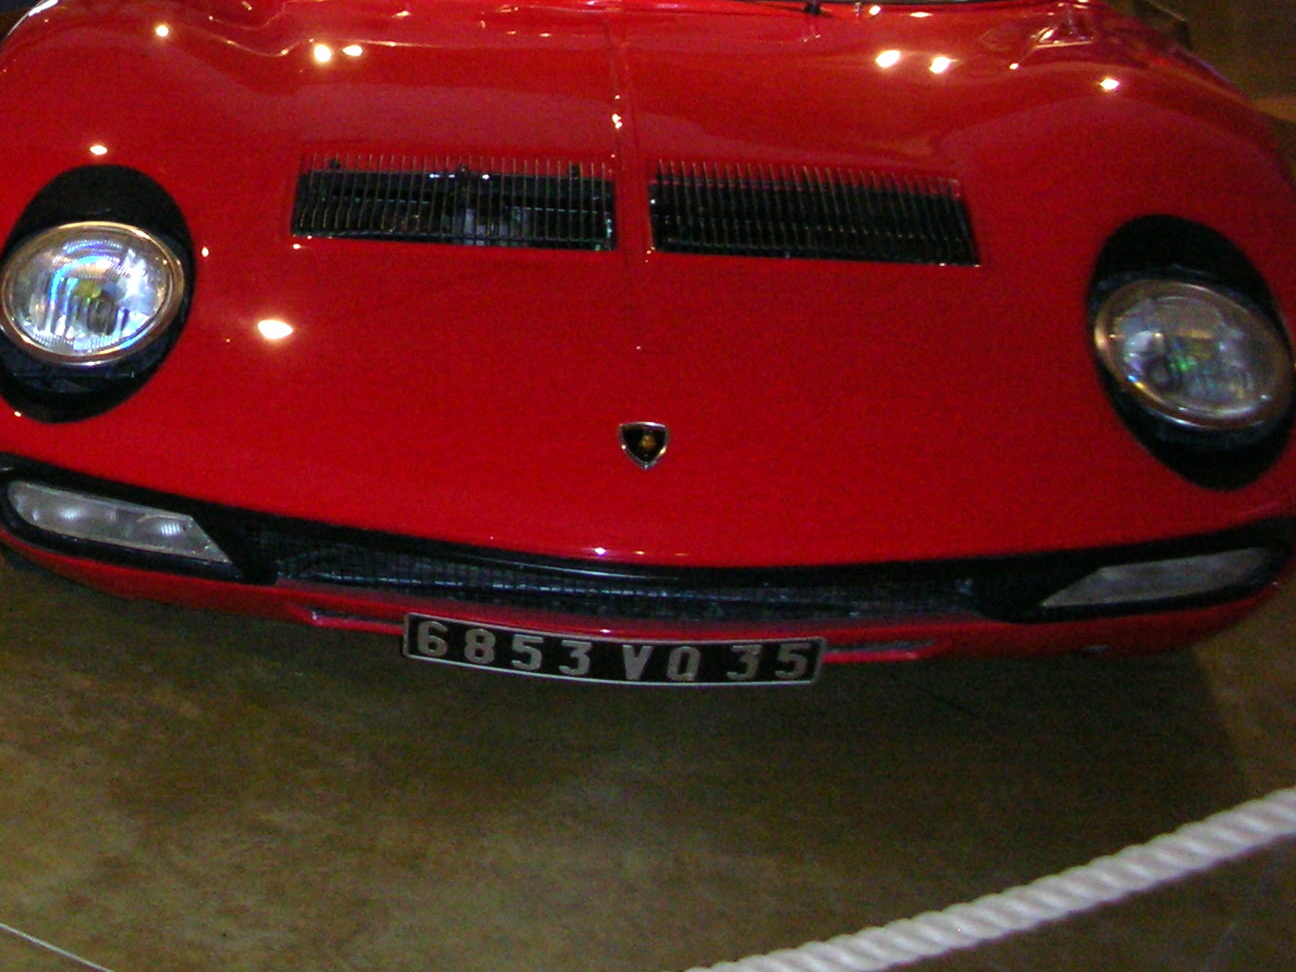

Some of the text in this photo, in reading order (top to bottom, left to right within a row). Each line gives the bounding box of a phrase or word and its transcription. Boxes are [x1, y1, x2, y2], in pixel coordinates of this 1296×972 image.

[417, 620, 812, 682] 6853 VQ 35
